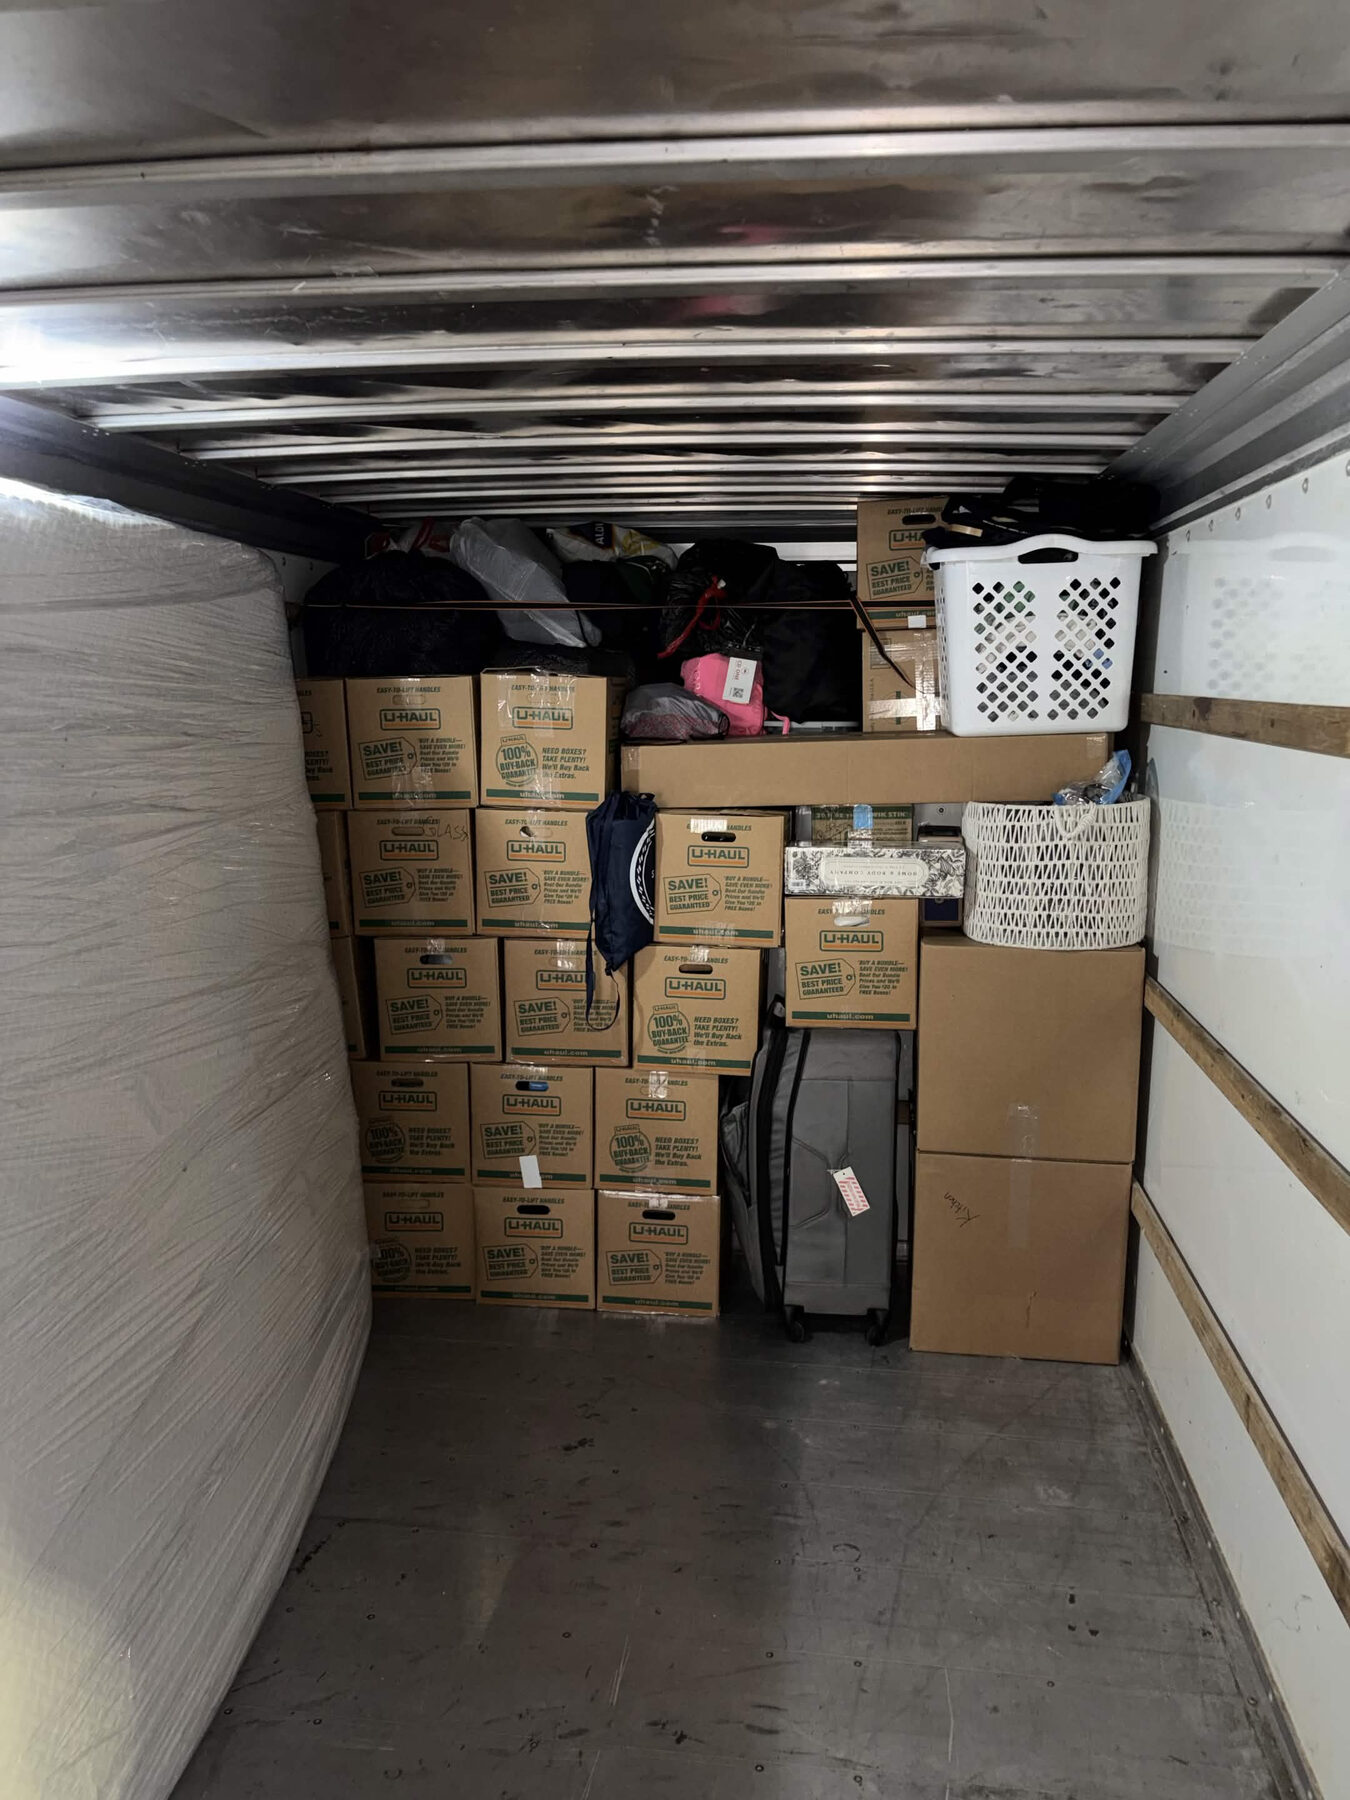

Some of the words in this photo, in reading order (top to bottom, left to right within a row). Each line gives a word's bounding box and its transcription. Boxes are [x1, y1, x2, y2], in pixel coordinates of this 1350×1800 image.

[594, 523, 605, 545] ALDI
[871, 561, 909, 576] SAVE!
[872, 579, 889, 588] BEST
[891, 576, 910, 585] PRICE
[873, 584, 911, 596] GUARANTEED
[384, 712, 437, 722] U-HAUL
[517, 710, 569, 721] U-HAUL
[363, 742, 402, 756] SAVE!
[501, 745, 530, 760] 100%
[500, 759, 535, 771] BUY-BACK
[384, 843, 435, 852] U-HAUL
[511, 844, 562, 854] U-HAUL
[692, 849, 745, 860] U-HAUL
[364, 871, 402, 885] SAVE!
[489, 872, 527, 884] SAVE!
[668, 878, 708, 891] SAVE!
[492, 895, 530, 904] GUARANTEED
[670, 902, 710, 910] GUARANTEED
[824, 934, 879, 944] U-HAUL
[800, 962, 842, 976] SAVE!
[411, 971, 462, 981] U-HAUL
[540, 973, 583, 983] U-HAU
[669, 980, 722, 992] U-HAUL
[801, 980, 820, 989] BEST
[821, 978, 842, 986] PRICE
[802, 986, 844, 996] GUARANTEED
[390, 998, 429, 1012] SAVE!
[518, 1001, 557, 1014] SAVE!
[411, 1014, 430, 1022] PRICE
[653, 1014, 682, 1029] 100%
[521, 1024, 559, 1033] GUARANTEED
[651, 1027, 687, 1039] BUY-BACK
[653, 1036, 689, 1046] GUARANTEE
[383, 1094, 433, 1103] U-HAUL
[506, 1098, 557, 1108] U-HAUL
[630, 1102, 682, 1113] U-HAUL
[484, 1125, 522, 1137] SAVE!
[615, 1135, 644, 1149] 100%
[613, 1147, 648, 1159] BUY-BACK
[389, 1215, 440, 1224] U-HAUL
[508, 1221, 559, 1230] U-HAUL
[633, 1226, 684, 1237] U-HAUL
[487, 1247, 525, 1260] SAVE!
[610, 1253, 649, 1265] SAVE!
